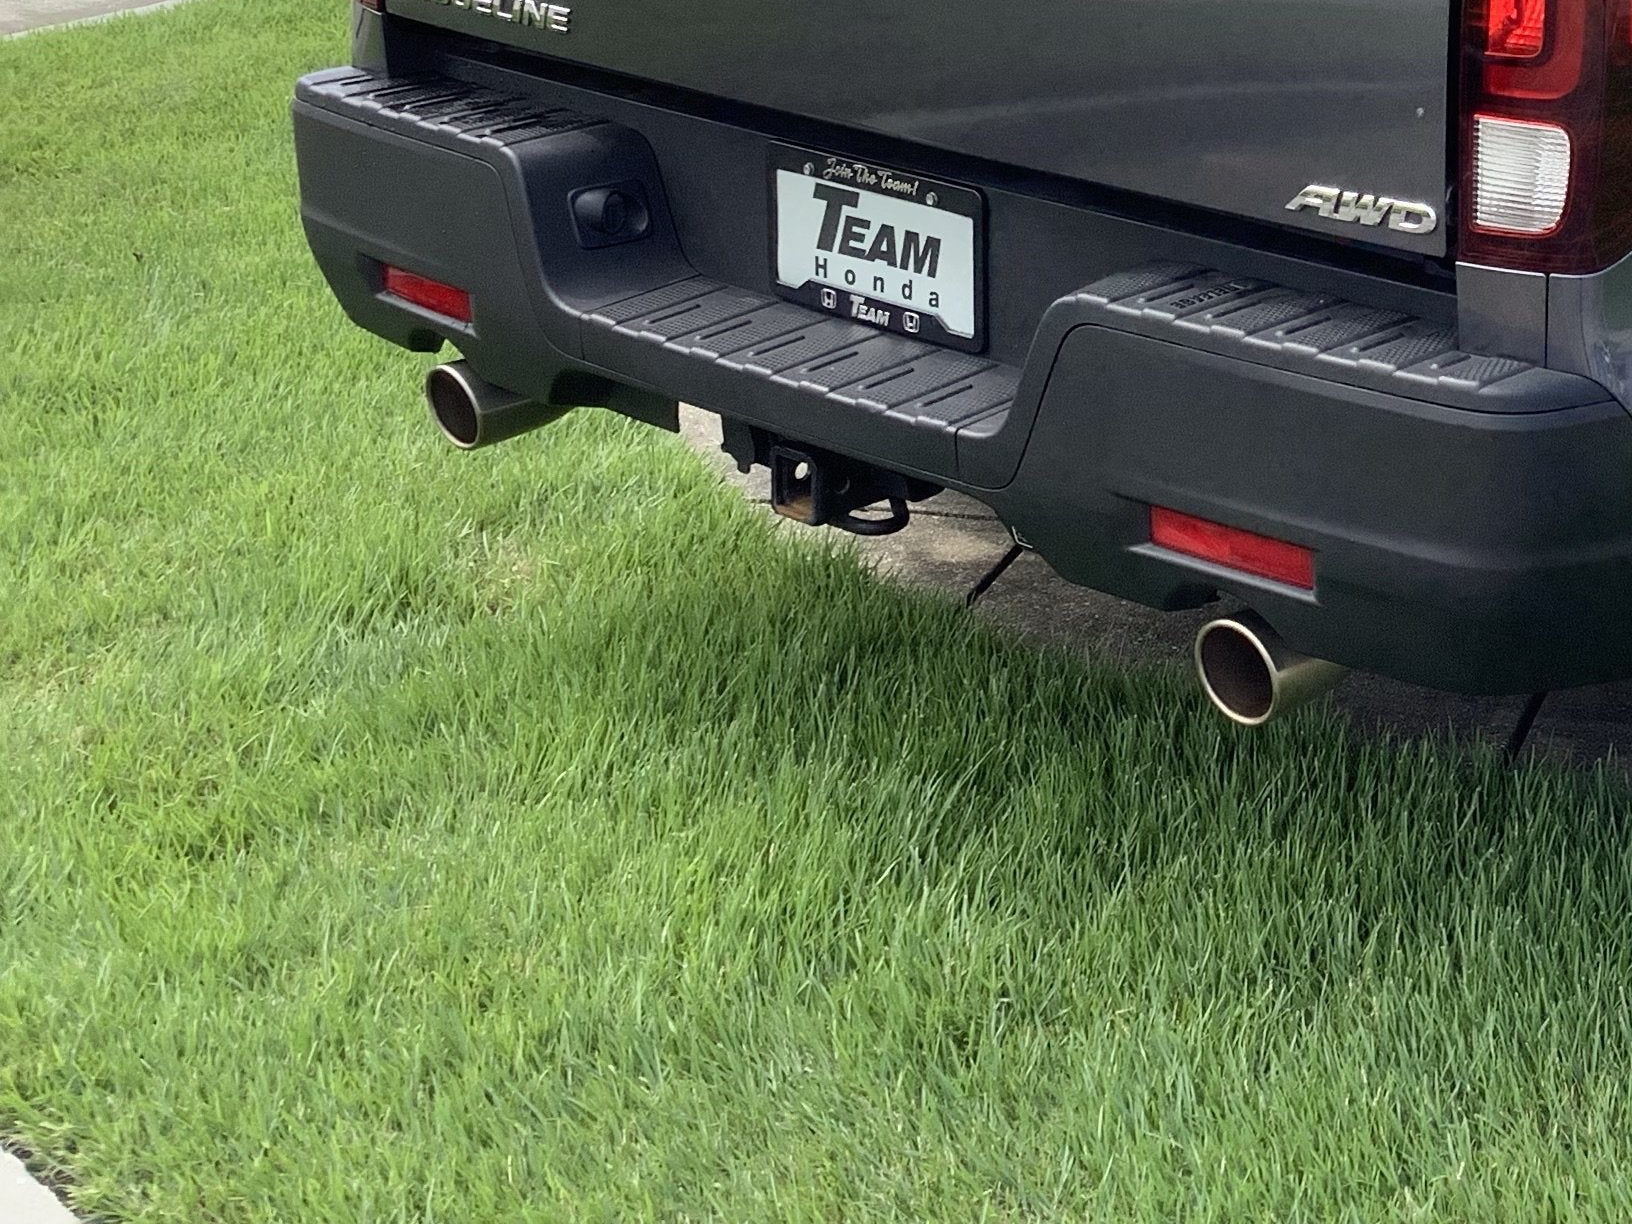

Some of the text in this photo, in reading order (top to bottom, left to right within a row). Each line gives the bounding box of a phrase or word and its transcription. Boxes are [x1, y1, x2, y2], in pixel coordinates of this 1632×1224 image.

[823, 158, 919, 196] Join The Team!
[813, 182, 942, 279] TEAM
[1285, 184, 1437, 234] AWD
[815, 256, 940, 308] Honda
[850, 294, 890, 326] TEAM
